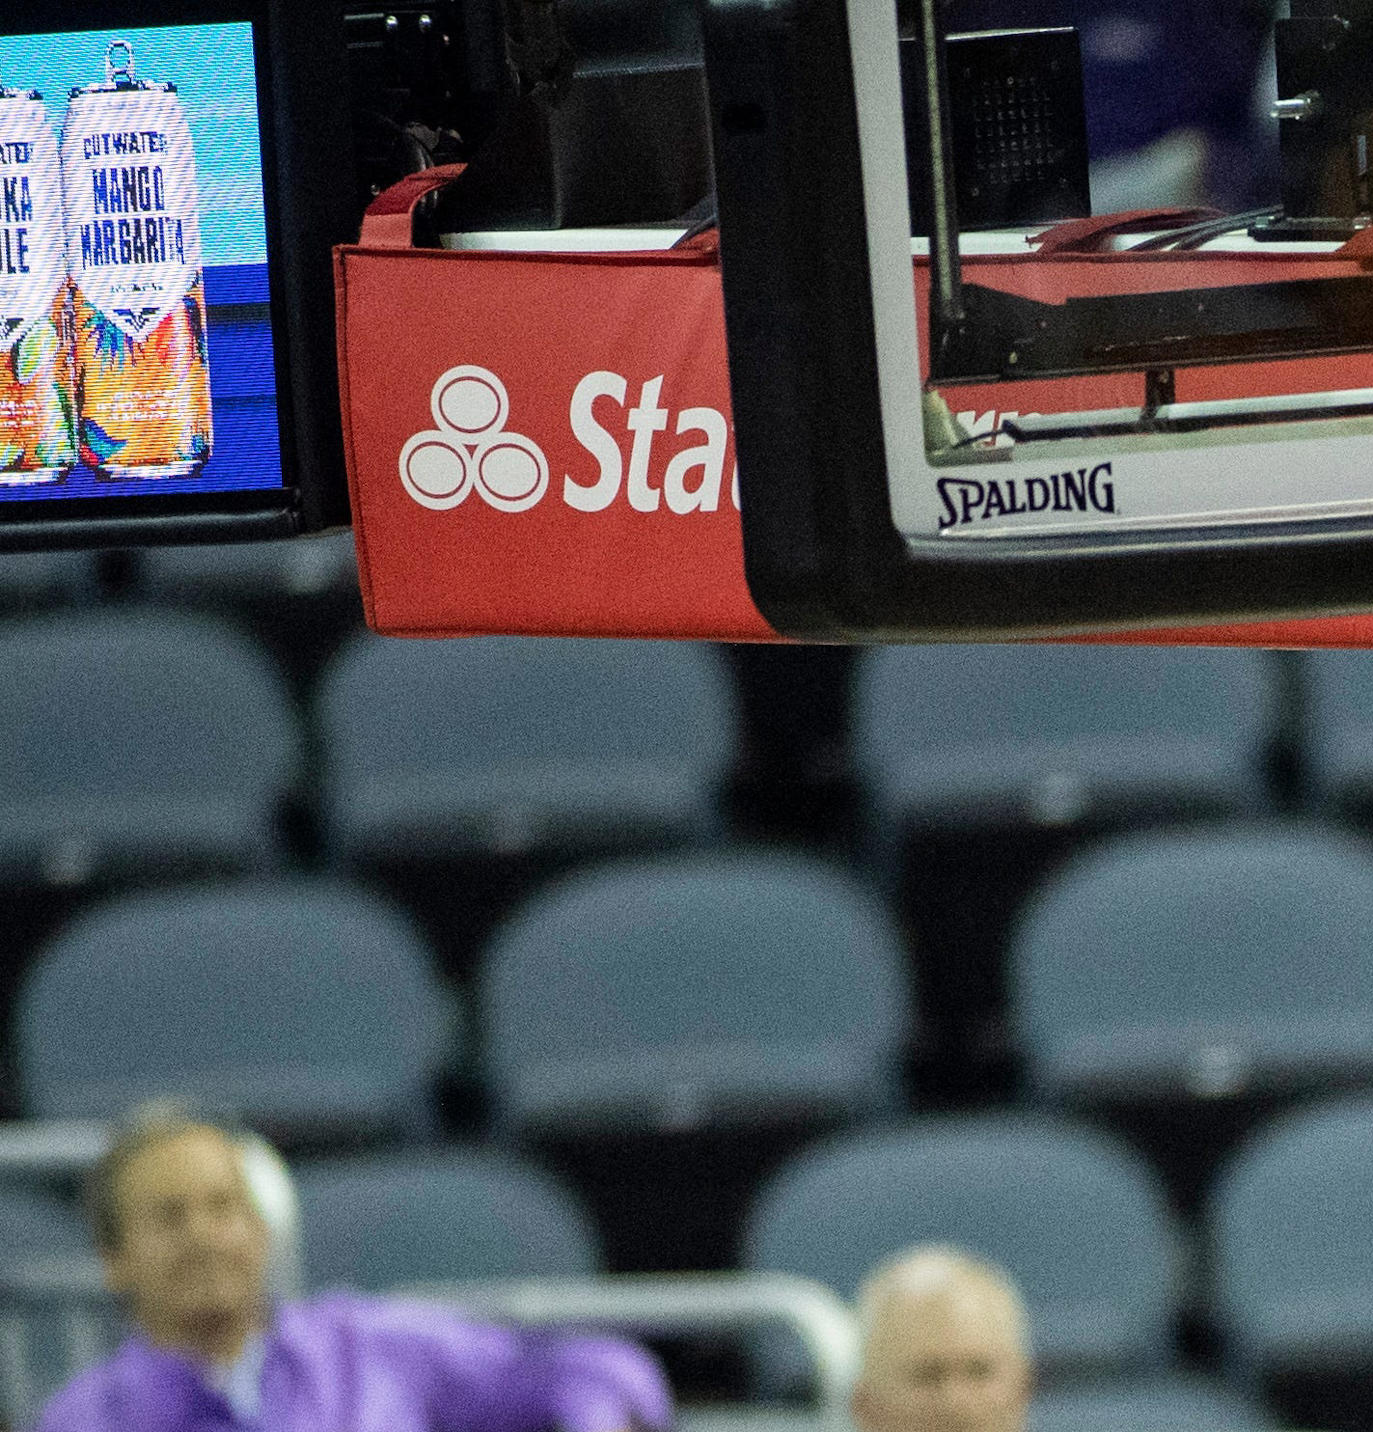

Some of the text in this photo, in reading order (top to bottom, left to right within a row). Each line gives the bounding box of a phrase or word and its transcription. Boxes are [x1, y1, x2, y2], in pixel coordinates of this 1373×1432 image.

[0, 176, 32, 222] KA
[92, 165, 165, 215] MANGO
[0, 228, 30, 273] LE
[80, 217, 186, 270] MARGARITA
[562, 370, 742, 515] Sta
[936, 461, 1116, 530] SPALDING
